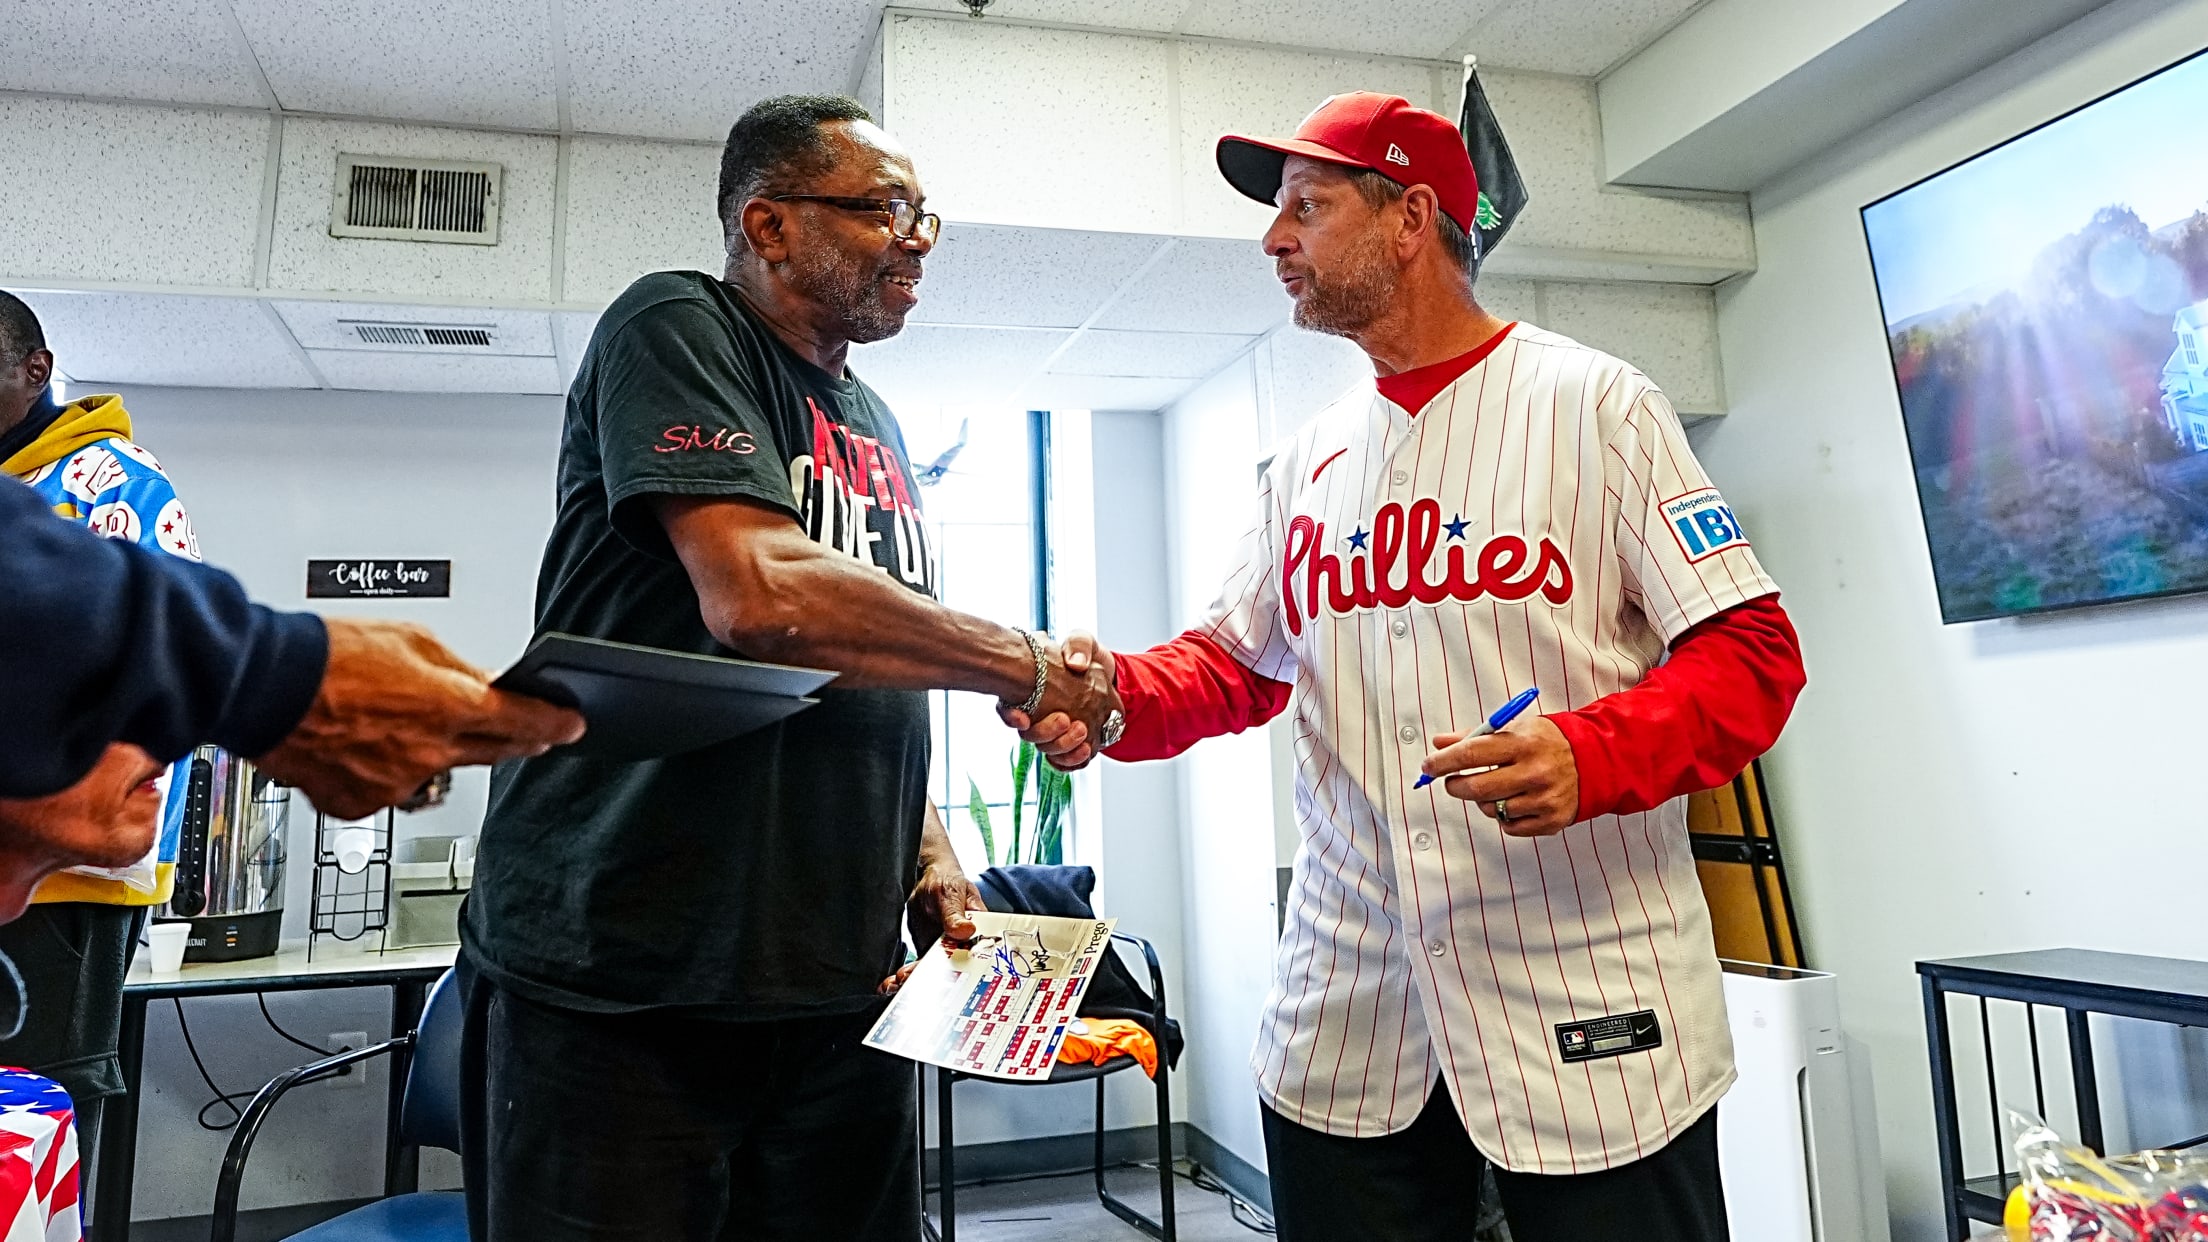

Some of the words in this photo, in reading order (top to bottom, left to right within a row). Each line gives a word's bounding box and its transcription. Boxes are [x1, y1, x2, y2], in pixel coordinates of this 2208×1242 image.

[654, 425, 757, 455] SMG
[1675, 505, 1744, 556] IBX
[328, 562, 391, 589] Coffee
[394, 562, 430, 584] bar
[1281, 497, 1574, 637] Phillies
[1083, 922, 1109, 954] Prego
